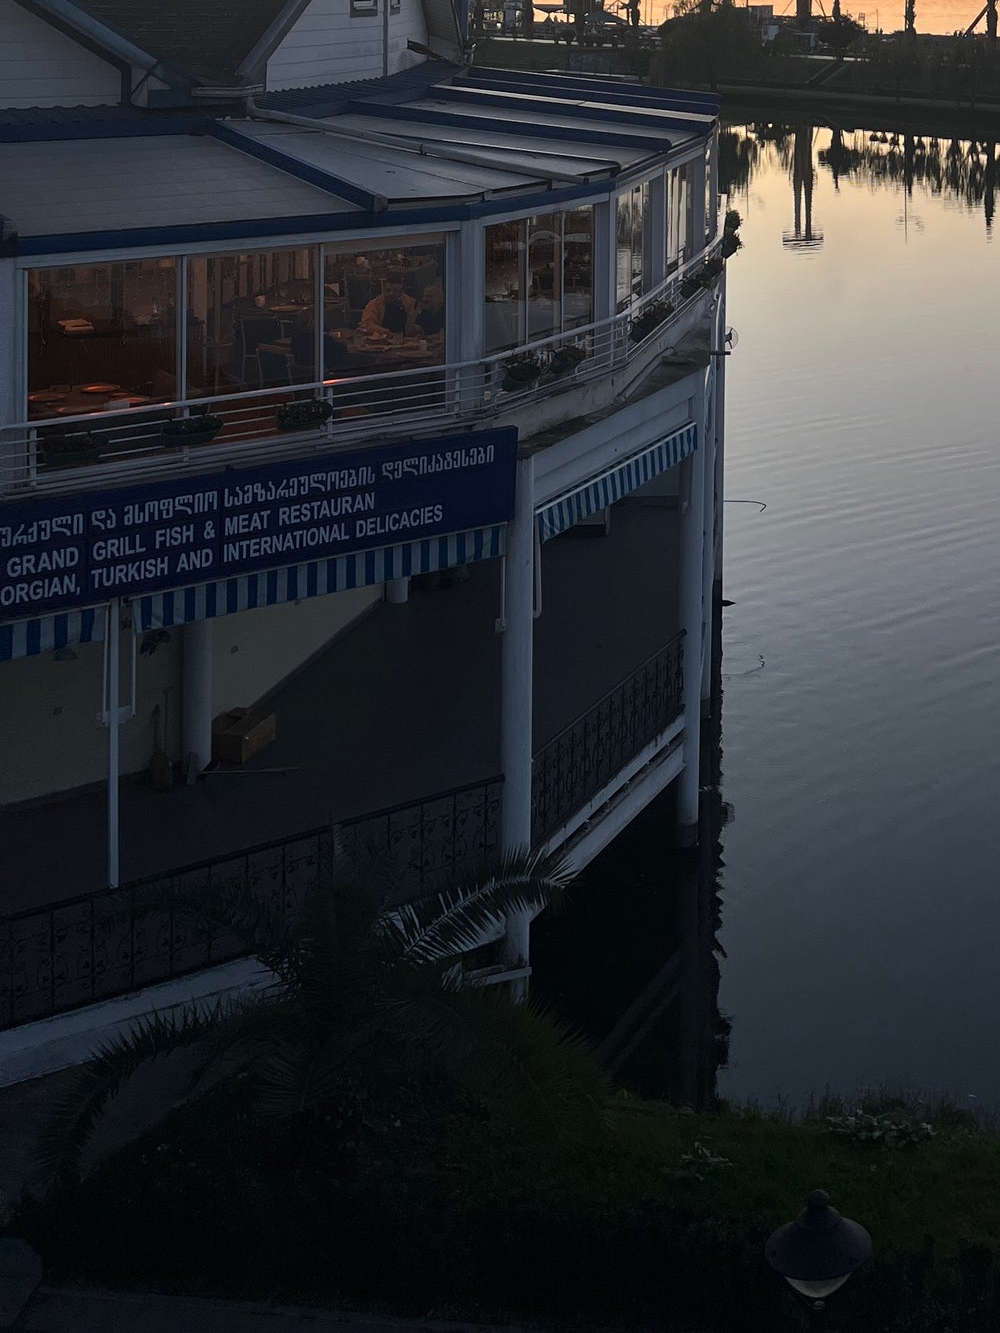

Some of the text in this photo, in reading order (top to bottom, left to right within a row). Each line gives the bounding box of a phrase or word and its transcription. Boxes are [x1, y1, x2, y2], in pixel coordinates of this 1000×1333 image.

[91, 508, 117, 530] და
[124, 490, 218, 525] მსოფლიო
[224, 466, 376, 508] სამზარეულოების
[382, 444, 495, 480] დელიკატესები
[0, 504, 443, 606] ORGIAN, TURKISH AND INTERNATIONAL DELICACIES
[7, 492, 376, 577] GRAND GRILL FISH & MEAT RESTAURAN
